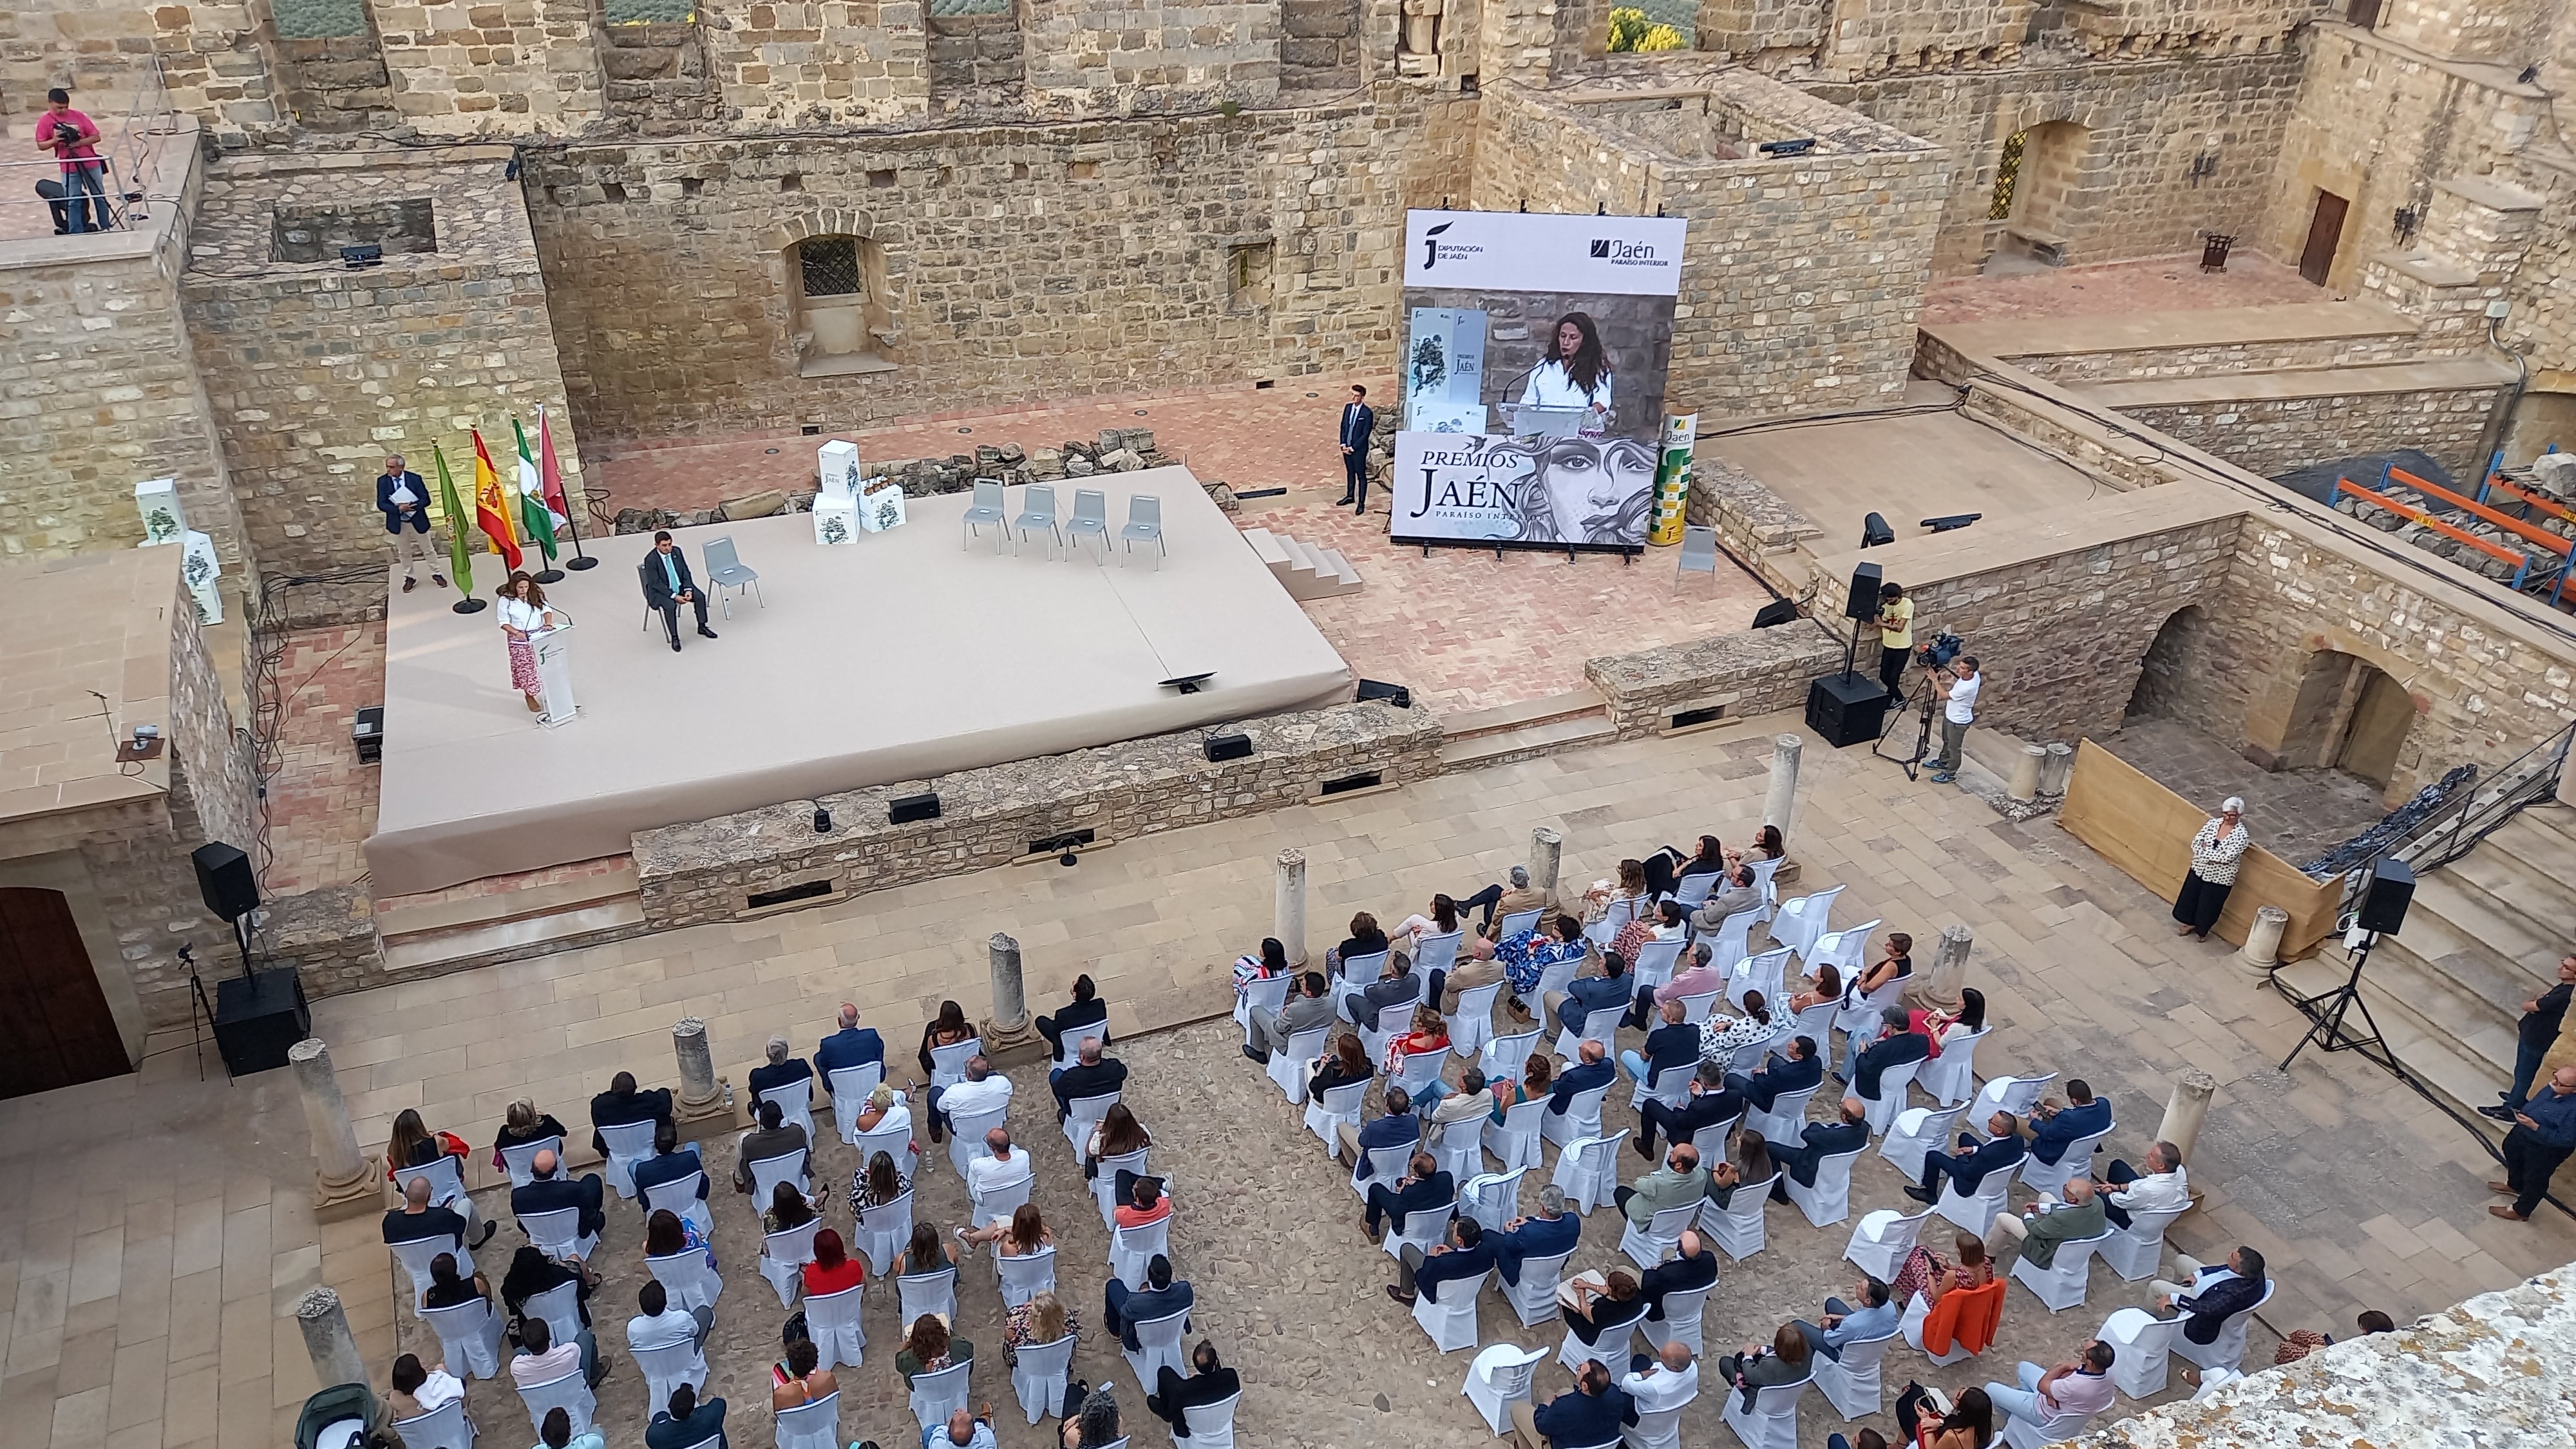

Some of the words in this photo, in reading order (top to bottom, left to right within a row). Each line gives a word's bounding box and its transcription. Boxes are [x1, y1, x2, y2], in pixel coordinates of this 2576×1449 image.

[1437, 245, 1484, 253] DIPUTACIÓN
[1611, 240, 1654, 259] Jaén
[1420, 451, 1520, 469] PREMIOS
[1410, 468, 1523, 518] JAÉN
[1435, 511, 1482, 519] PARAÍSO
[1487, 513, 1546, 522] INTERIOR
